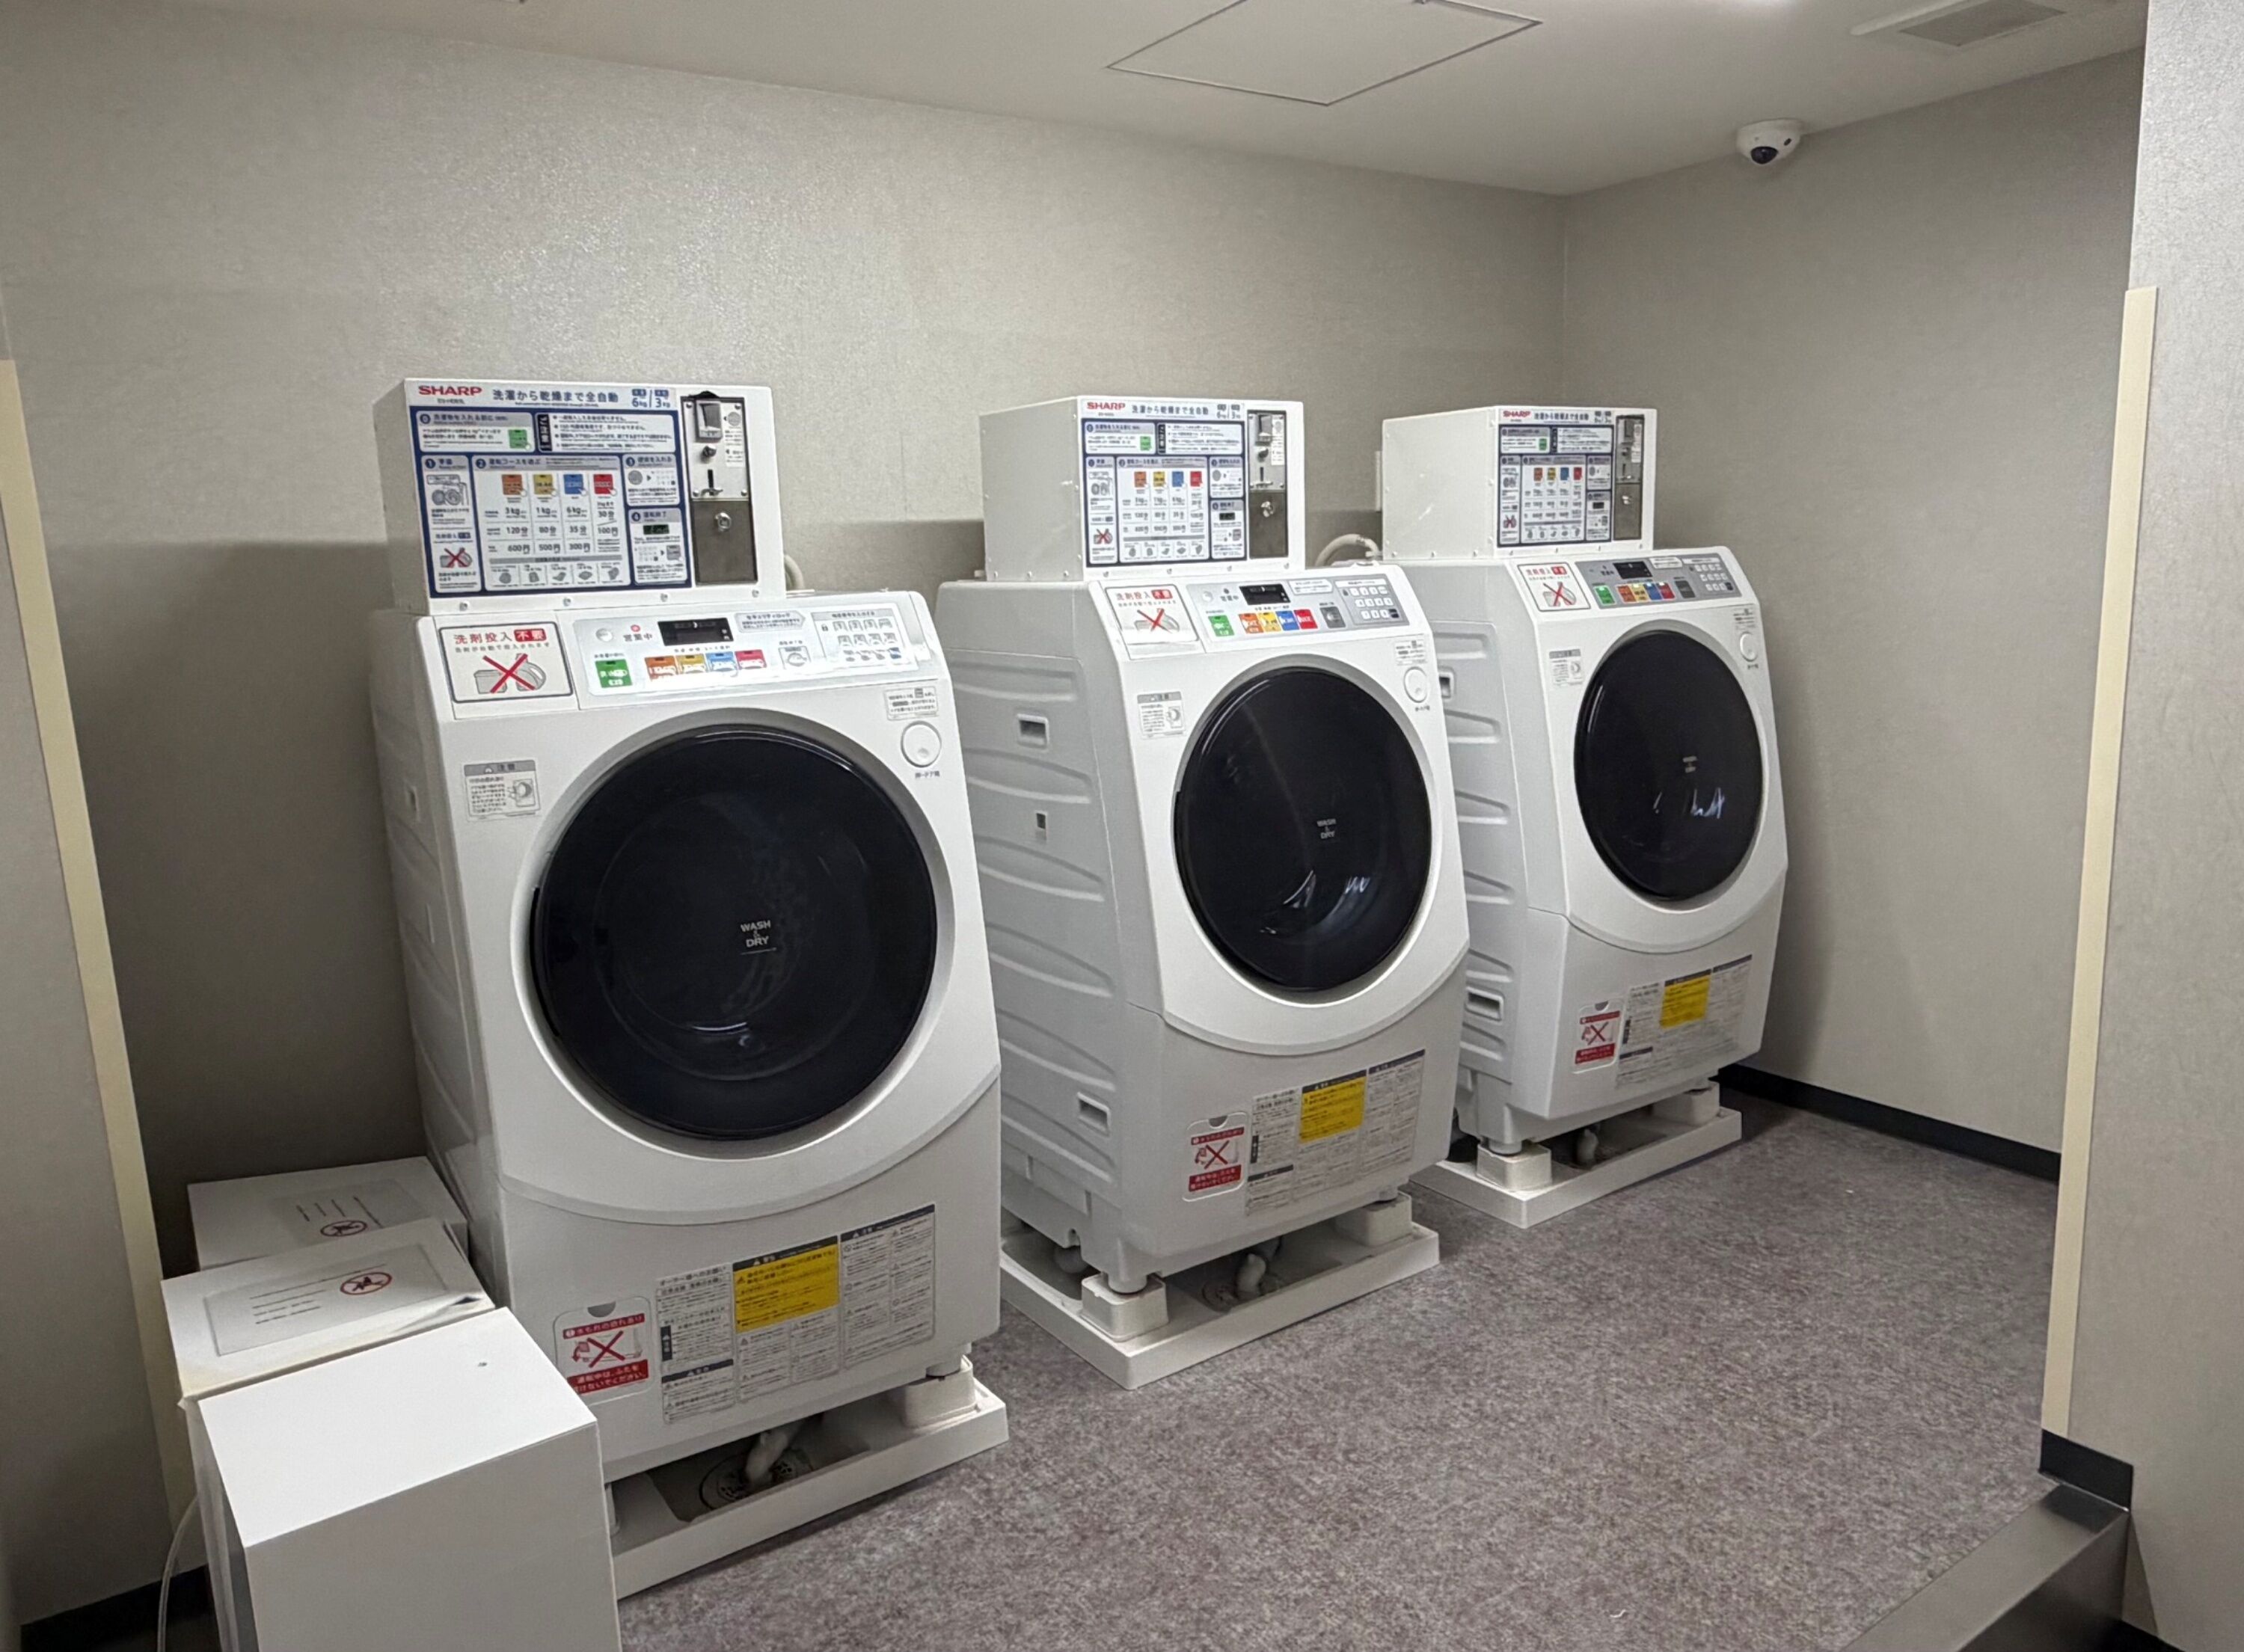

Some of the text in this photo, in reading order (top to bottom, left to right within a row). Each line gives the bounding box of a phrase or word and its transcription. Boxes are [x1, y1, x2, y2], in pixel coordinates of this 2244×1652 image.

[418, 385, 482, 396] SHARP
[492, 389, 619, 402] 洗濯から乾燥まで全自動
[454, 632, 512, 645] 洗剤投入
[741, 920, 771, 933] WASH
[746, 936, 769, 948] DRY
